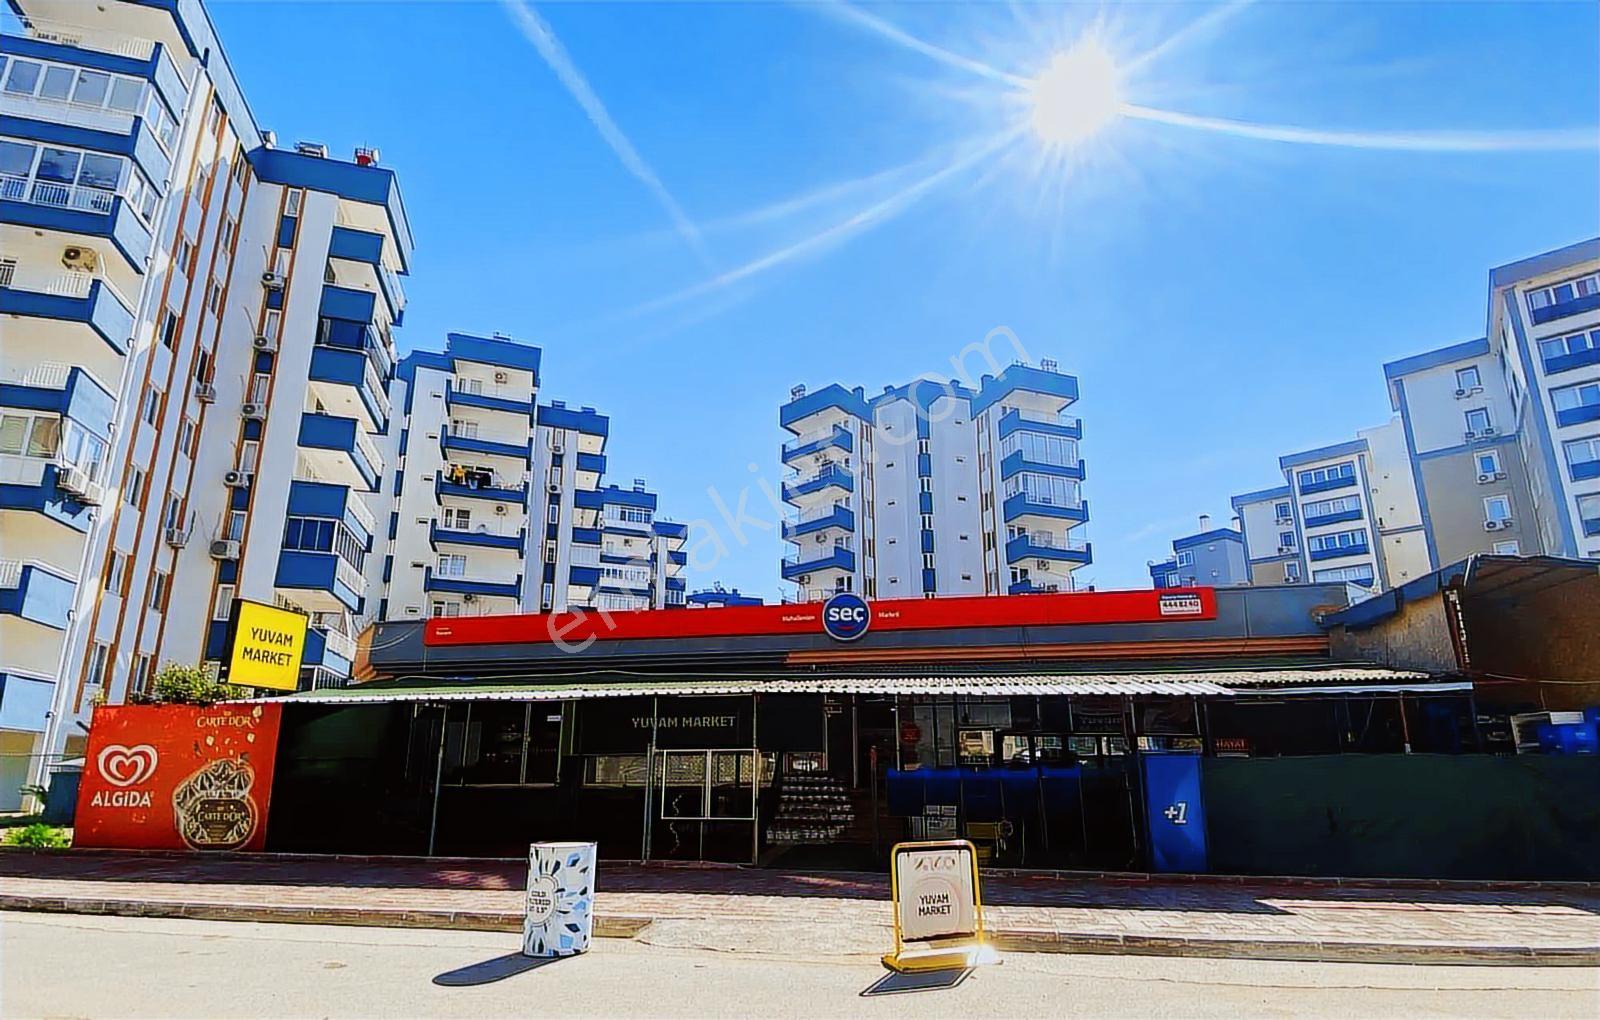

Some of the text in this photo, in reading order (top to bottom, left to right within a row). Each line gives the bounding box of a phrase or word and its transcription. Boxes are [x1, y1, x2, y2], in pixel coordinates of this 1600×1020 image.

[828, 606, 865, 623] seç
[251, 627, 293, 647] YUVAM
[242, 646, 293, 667] MARKET
[632, 716, 736, 728] YUVAM MARKET
[919, 893, 949, 905] YUVAM
[918, 904, 952, 917] MARKET
